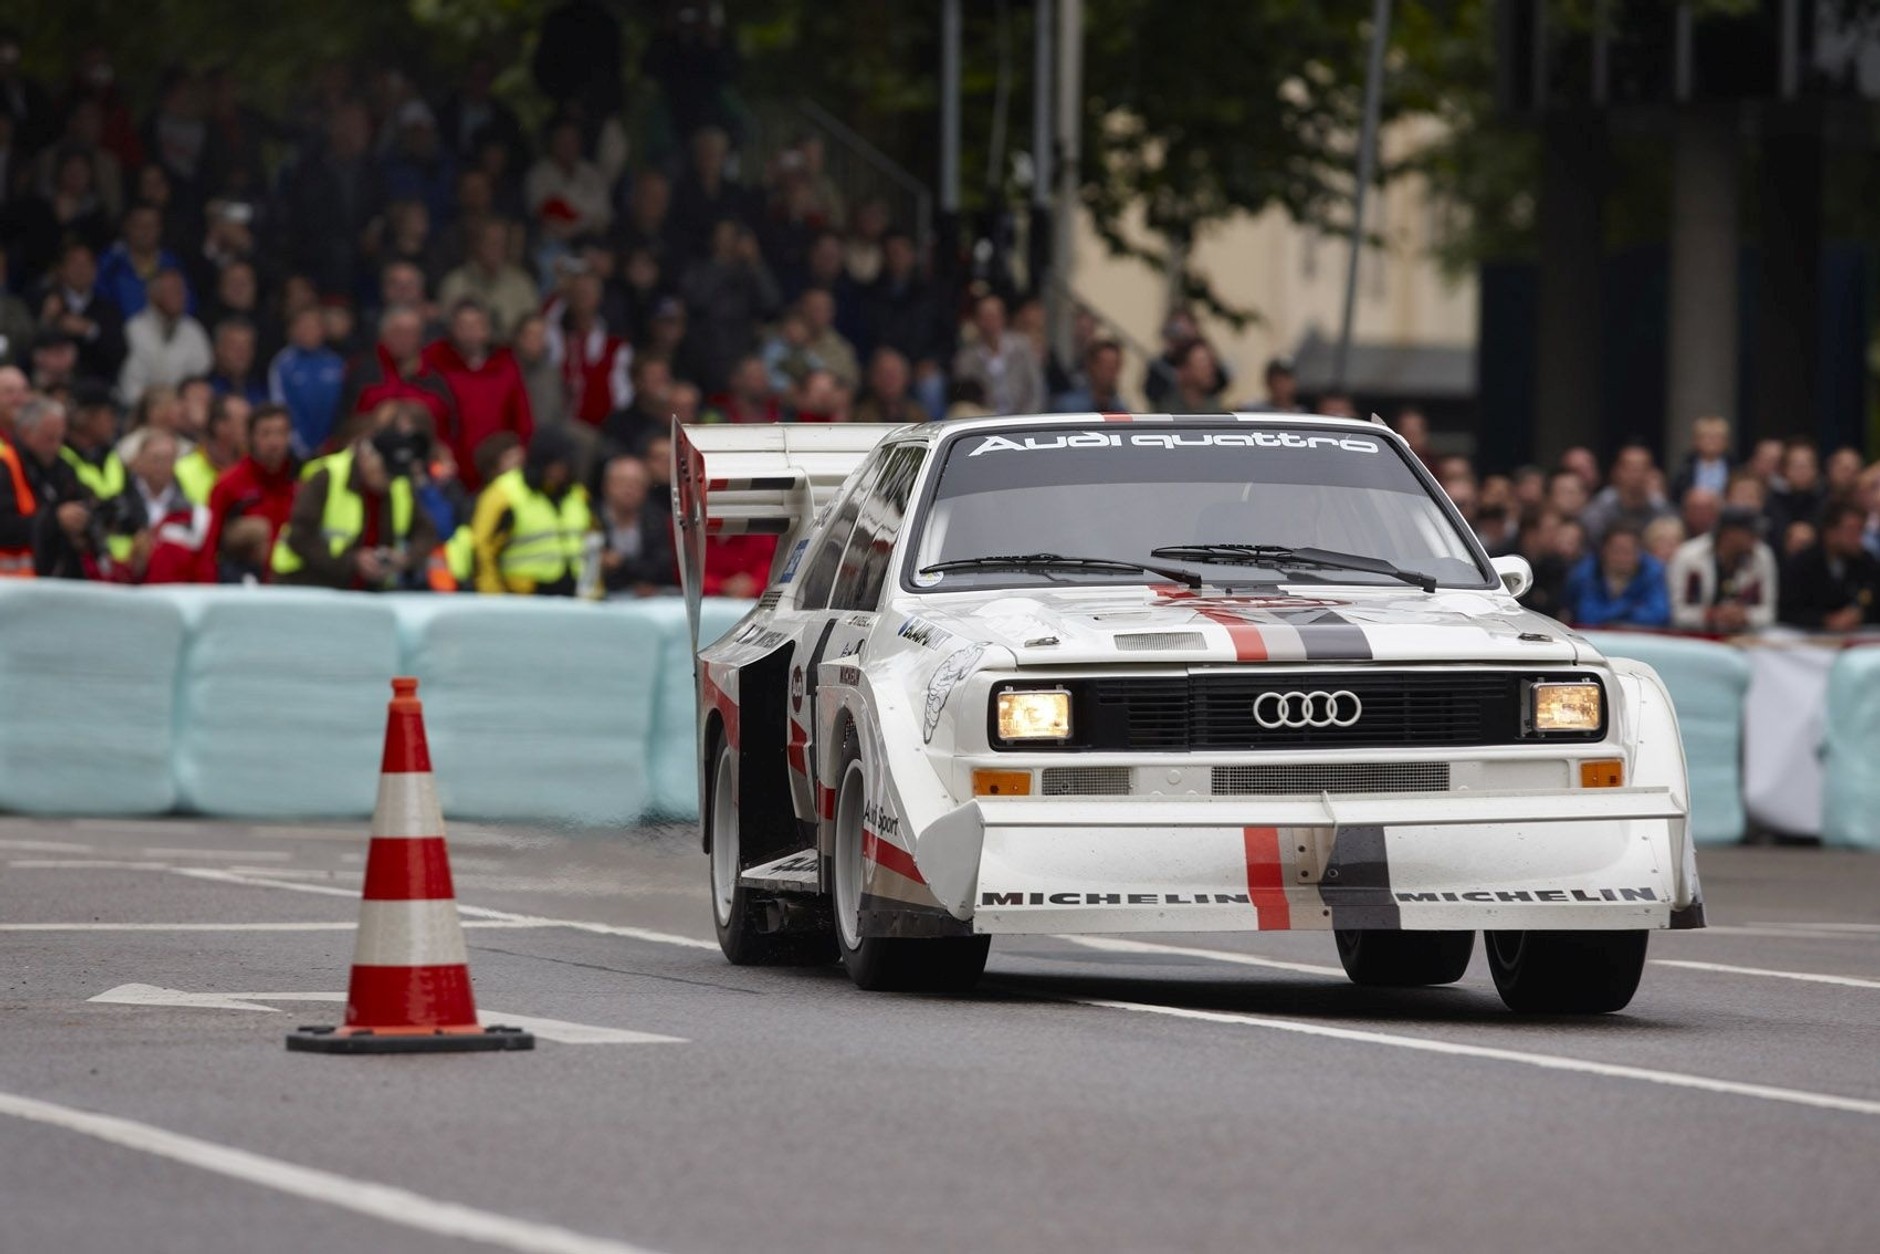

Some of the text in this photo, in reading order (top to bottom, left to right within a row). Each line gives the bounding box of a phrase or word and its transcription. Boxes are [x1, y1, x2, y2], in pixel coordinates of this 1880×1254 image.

[968, 431, 1379, 457] Audi quattro
[878, 806, 899, 836] Sport
[982, 892, 1250, 905] MICHELIN
[1395, 887, 1658, 902] MICHELIN
